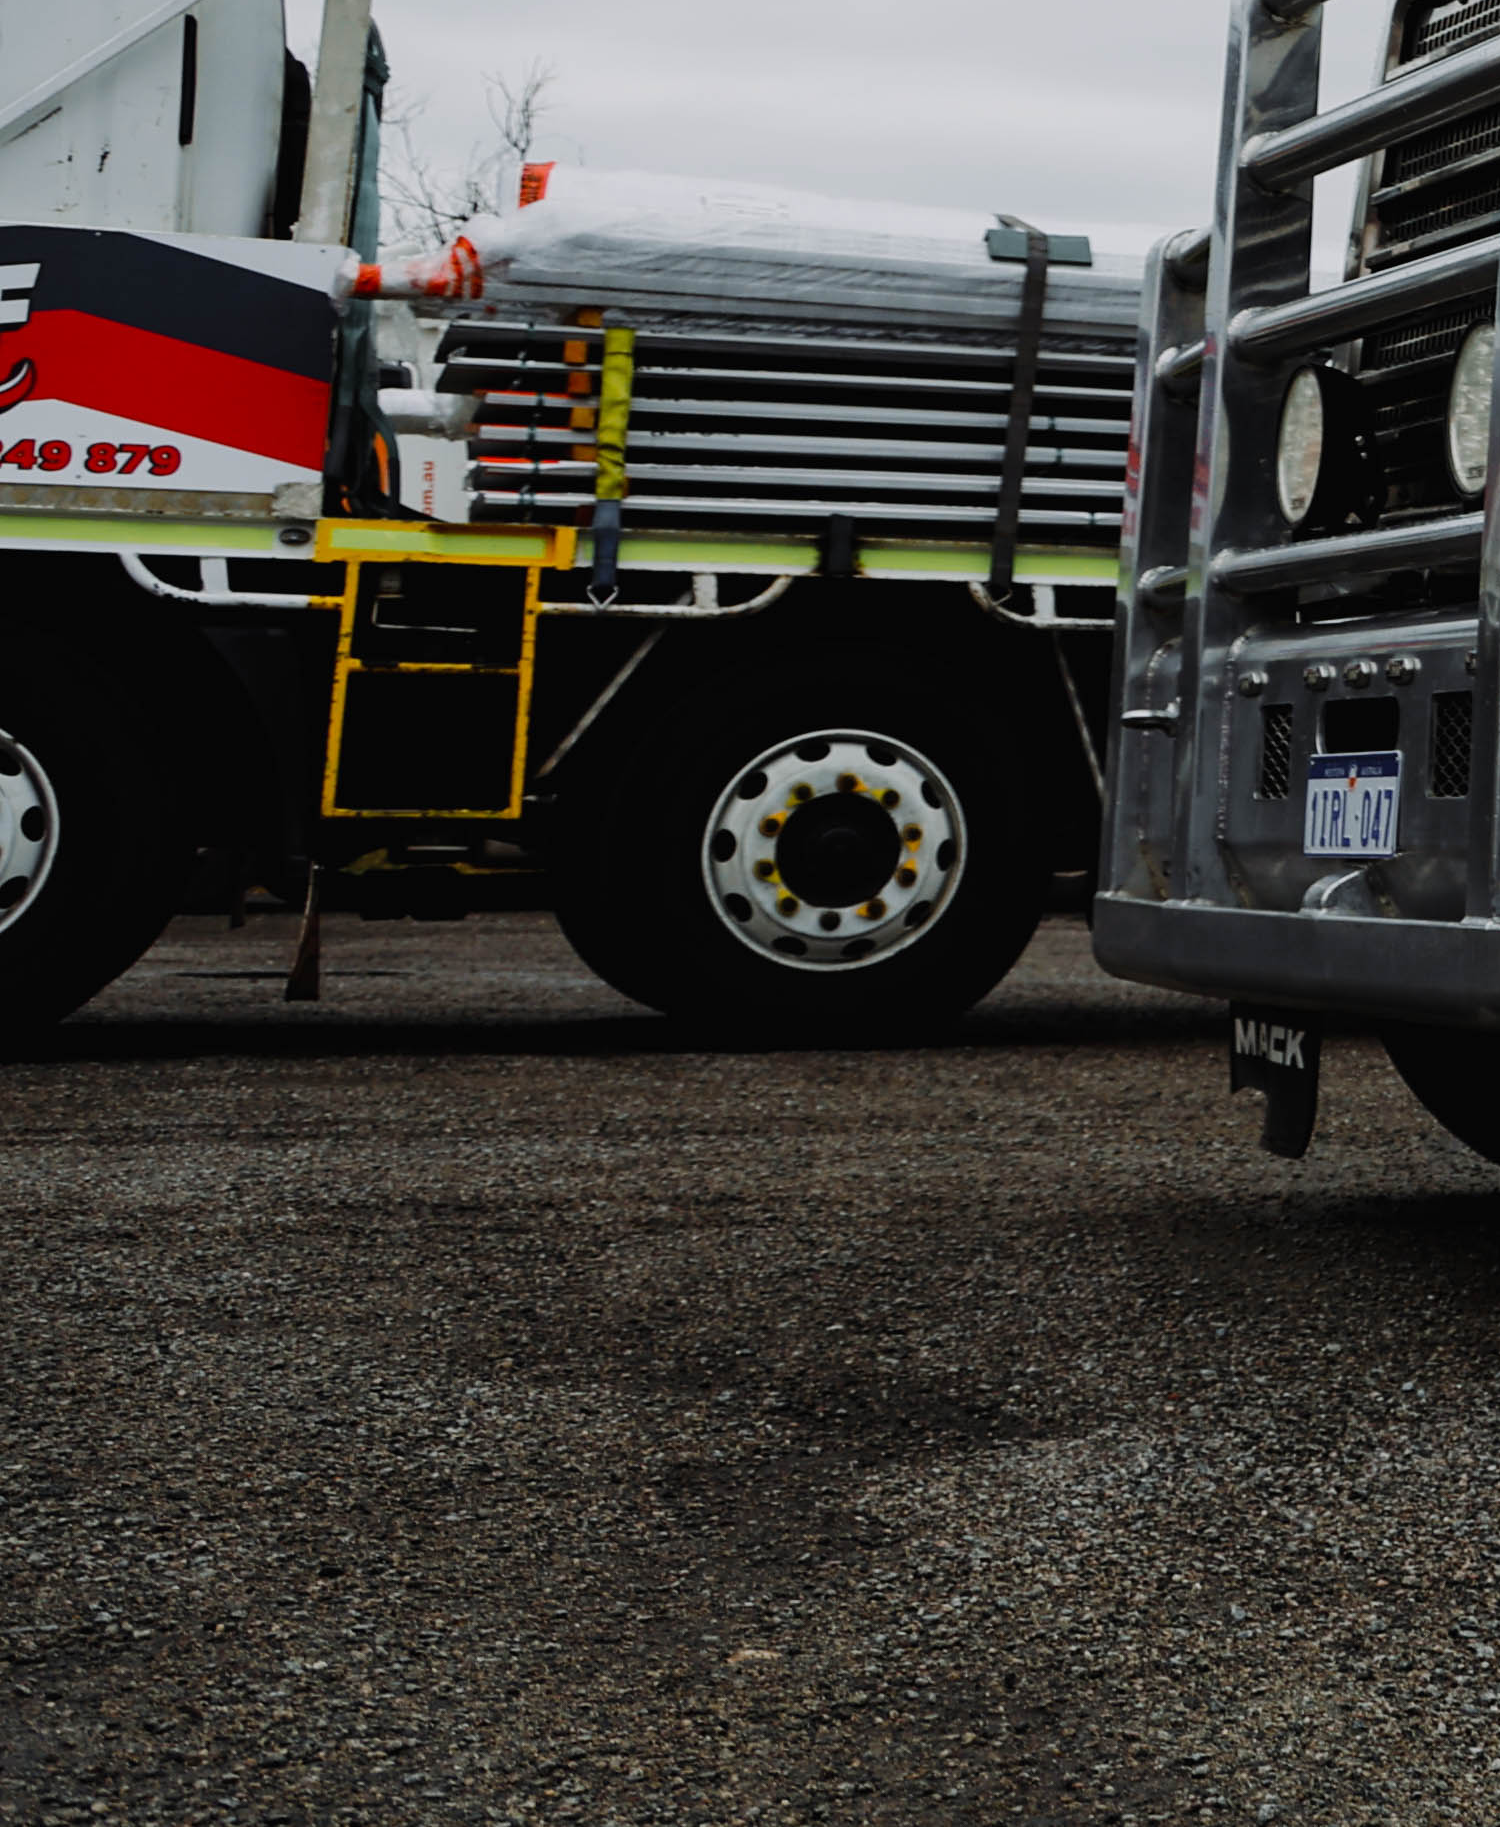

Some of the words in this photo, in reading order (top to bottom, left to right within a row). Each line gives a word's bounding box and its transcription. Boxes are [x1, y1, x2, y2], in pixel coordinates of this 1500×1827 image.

[0, 438, 72, 472] 49
[84, 442, 181, 476] 879
[1233, 1017, 1306, 1070] MACK
